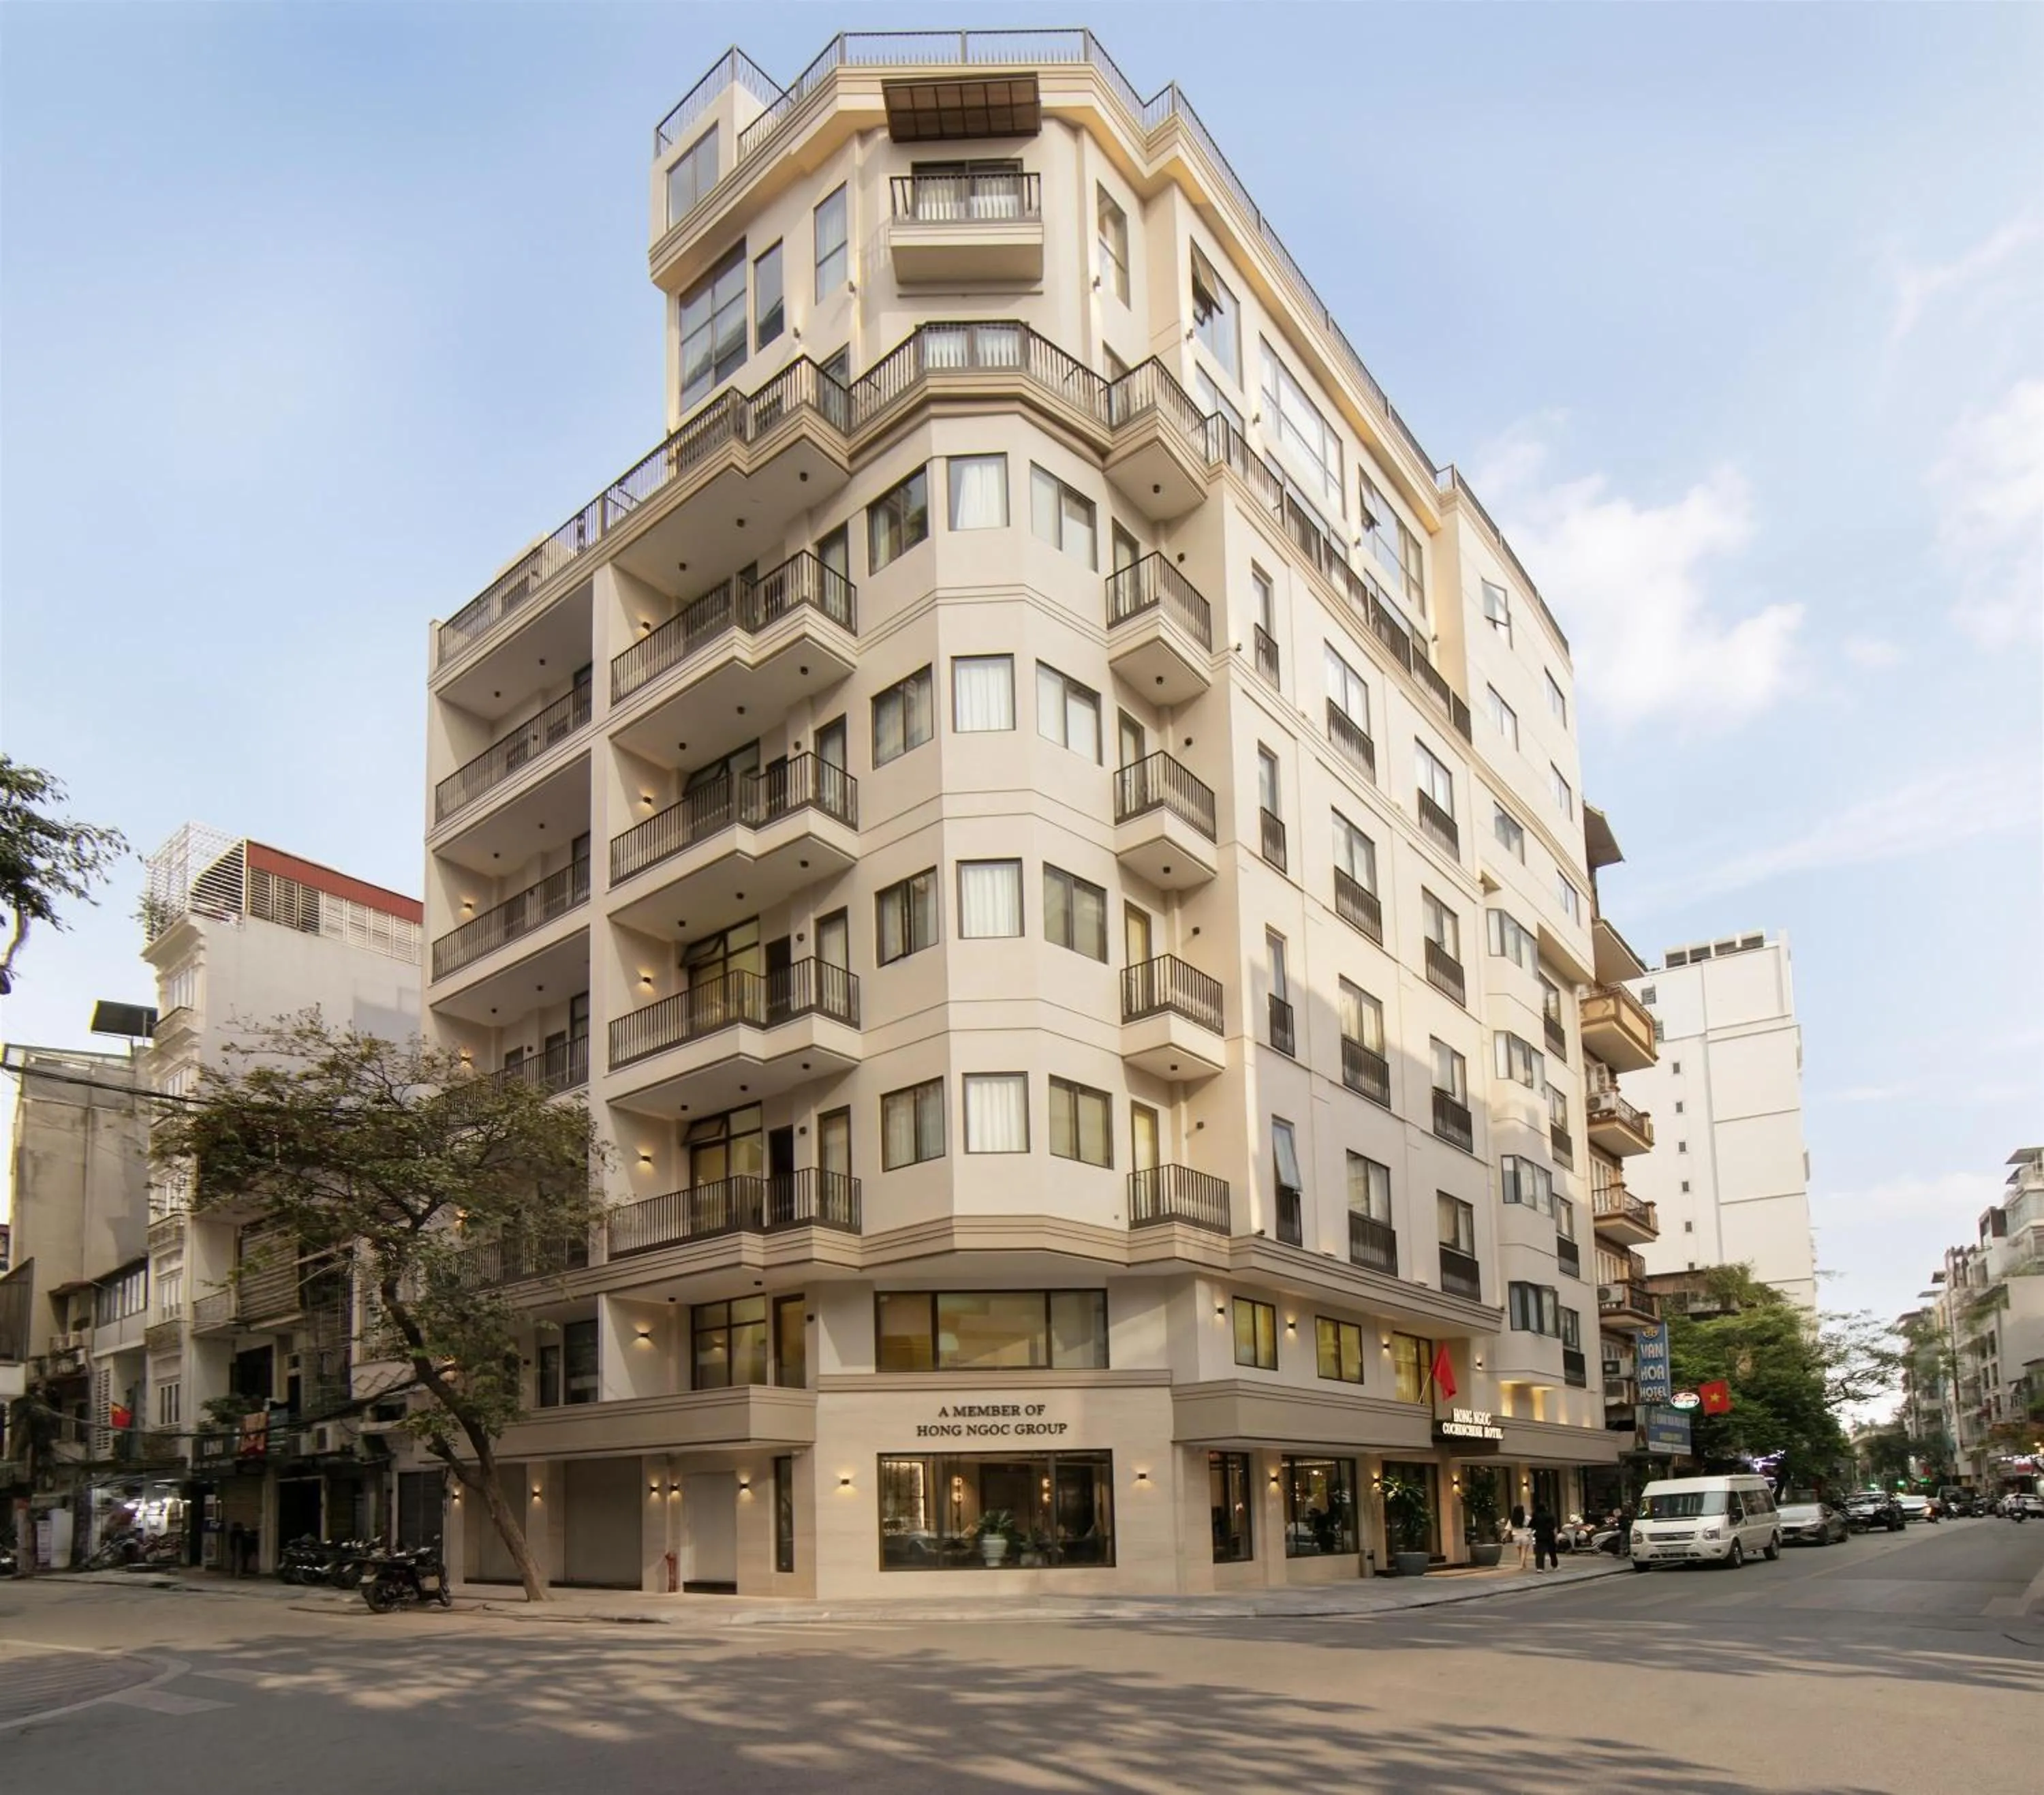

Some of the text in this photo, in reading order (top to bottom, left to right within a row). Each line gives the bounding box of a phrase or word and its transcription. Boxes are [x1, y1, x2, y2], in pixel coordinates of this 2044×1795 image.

[1640, 1343, 1664, 1359] VAN
[1640, 1365, 1665, 1382] HOA
[1641, 1385, 1668, 1398] HOTEL
[938, 1404, 1047, 1418] A MEMBER OF
[916, 1422, 1068, 1437] HONG NGOC GROUP
